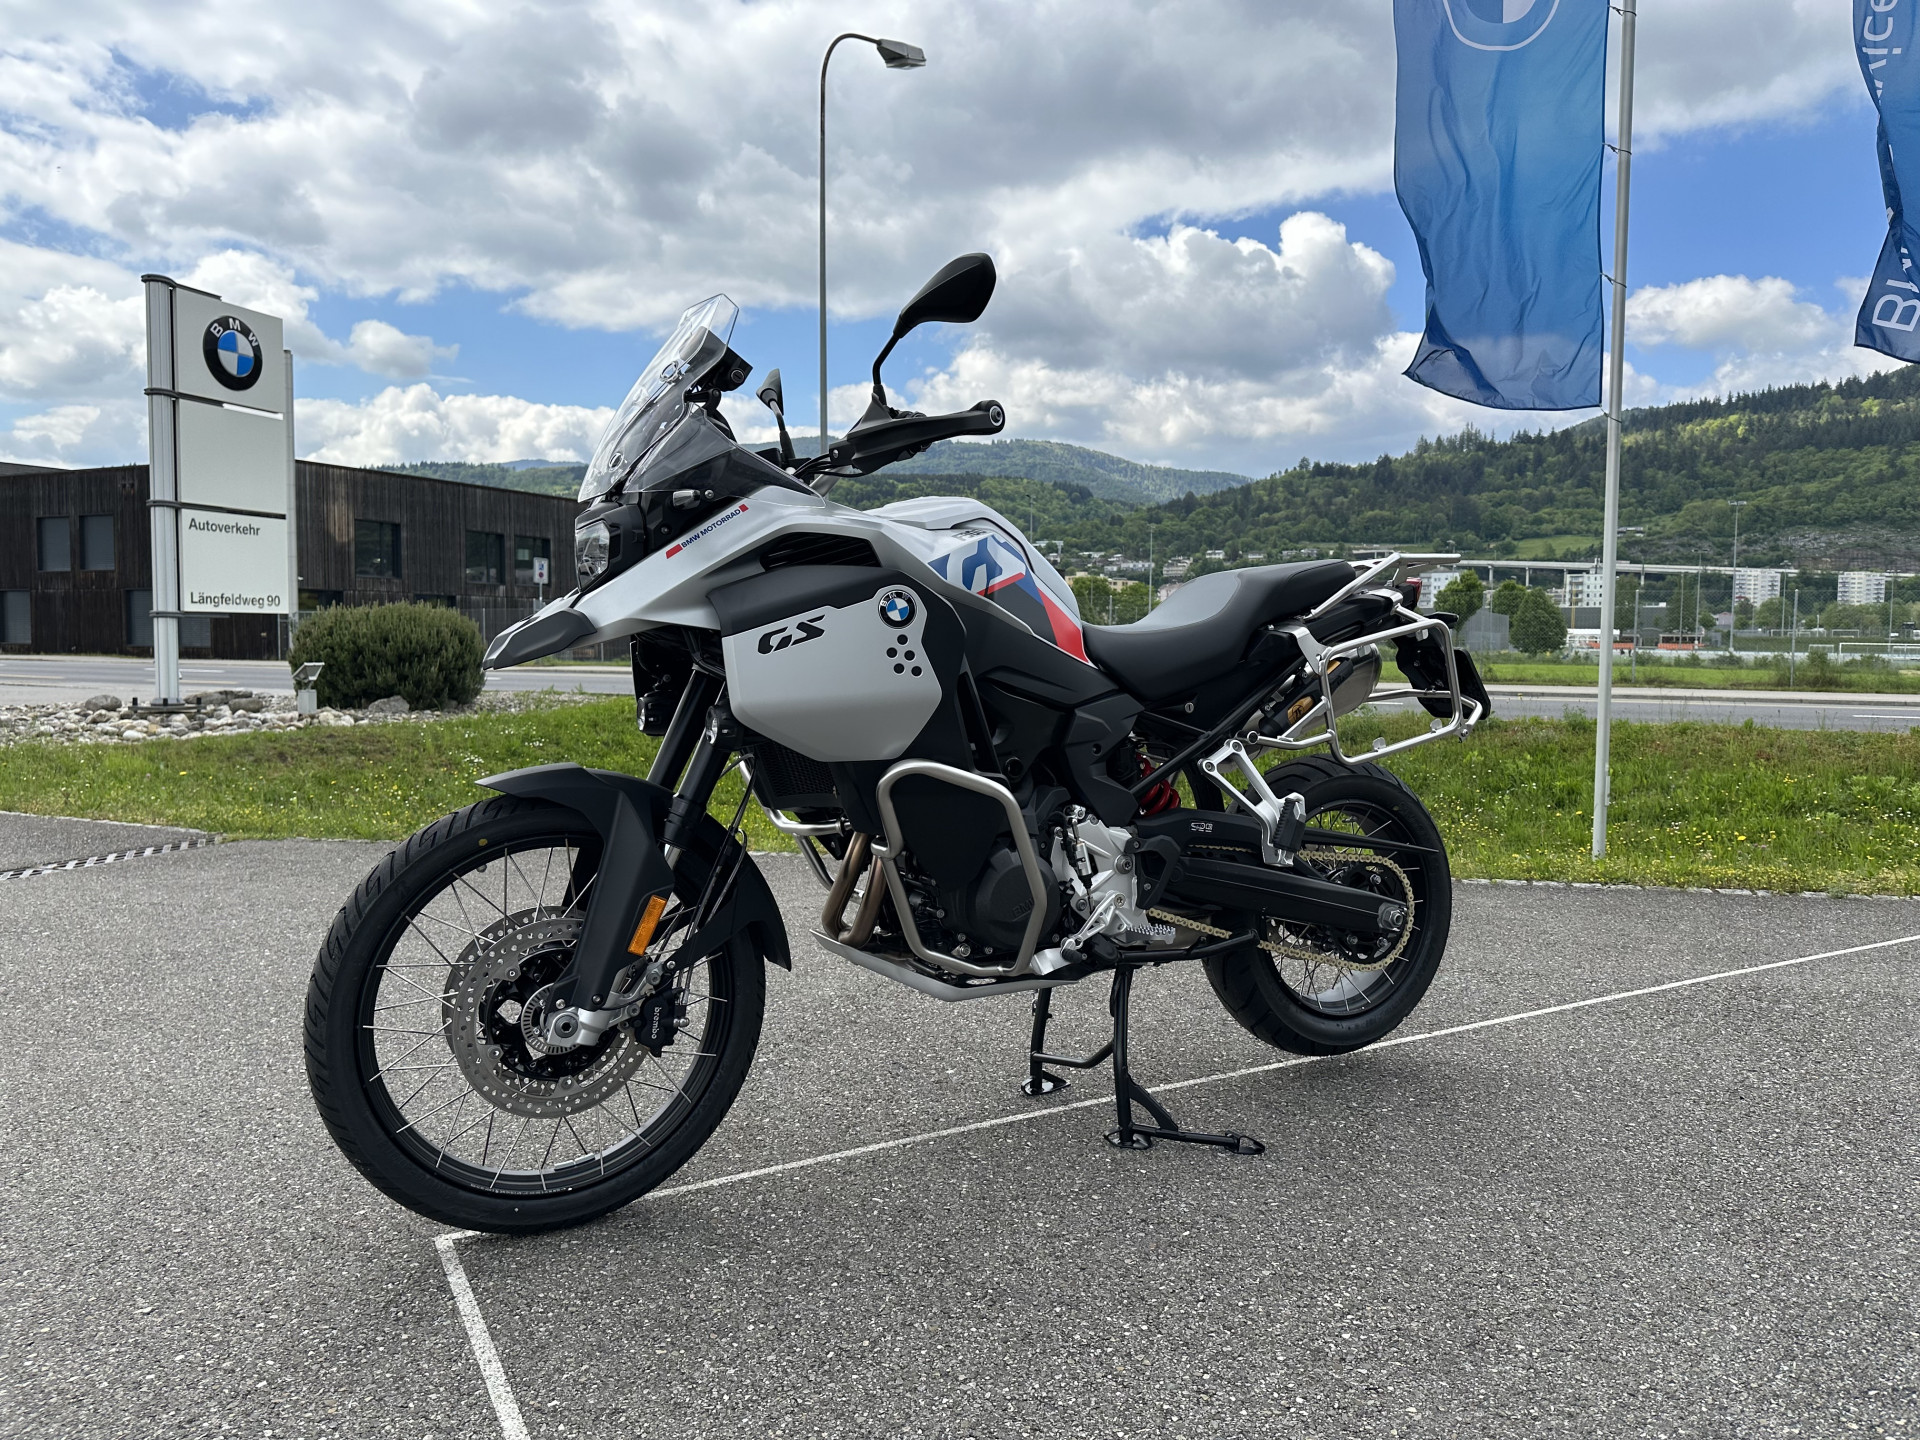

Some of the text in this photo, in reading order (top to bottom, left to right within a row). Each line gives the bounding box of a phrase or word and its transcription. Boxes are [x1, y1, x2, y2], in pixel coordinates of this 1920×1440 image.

[210, 317, 259, 347] BMW
[188, 517, 261, 536] Autoverkehr
[681, 508, 741, 548] BMW MOTORRAD
[190, 591, 281, 609] Längfeldweg 90
[757, 614, 825, 655] GS
[1013, 898, 1035, 918] BM
[651, 1006, 662, 1039] brembo
